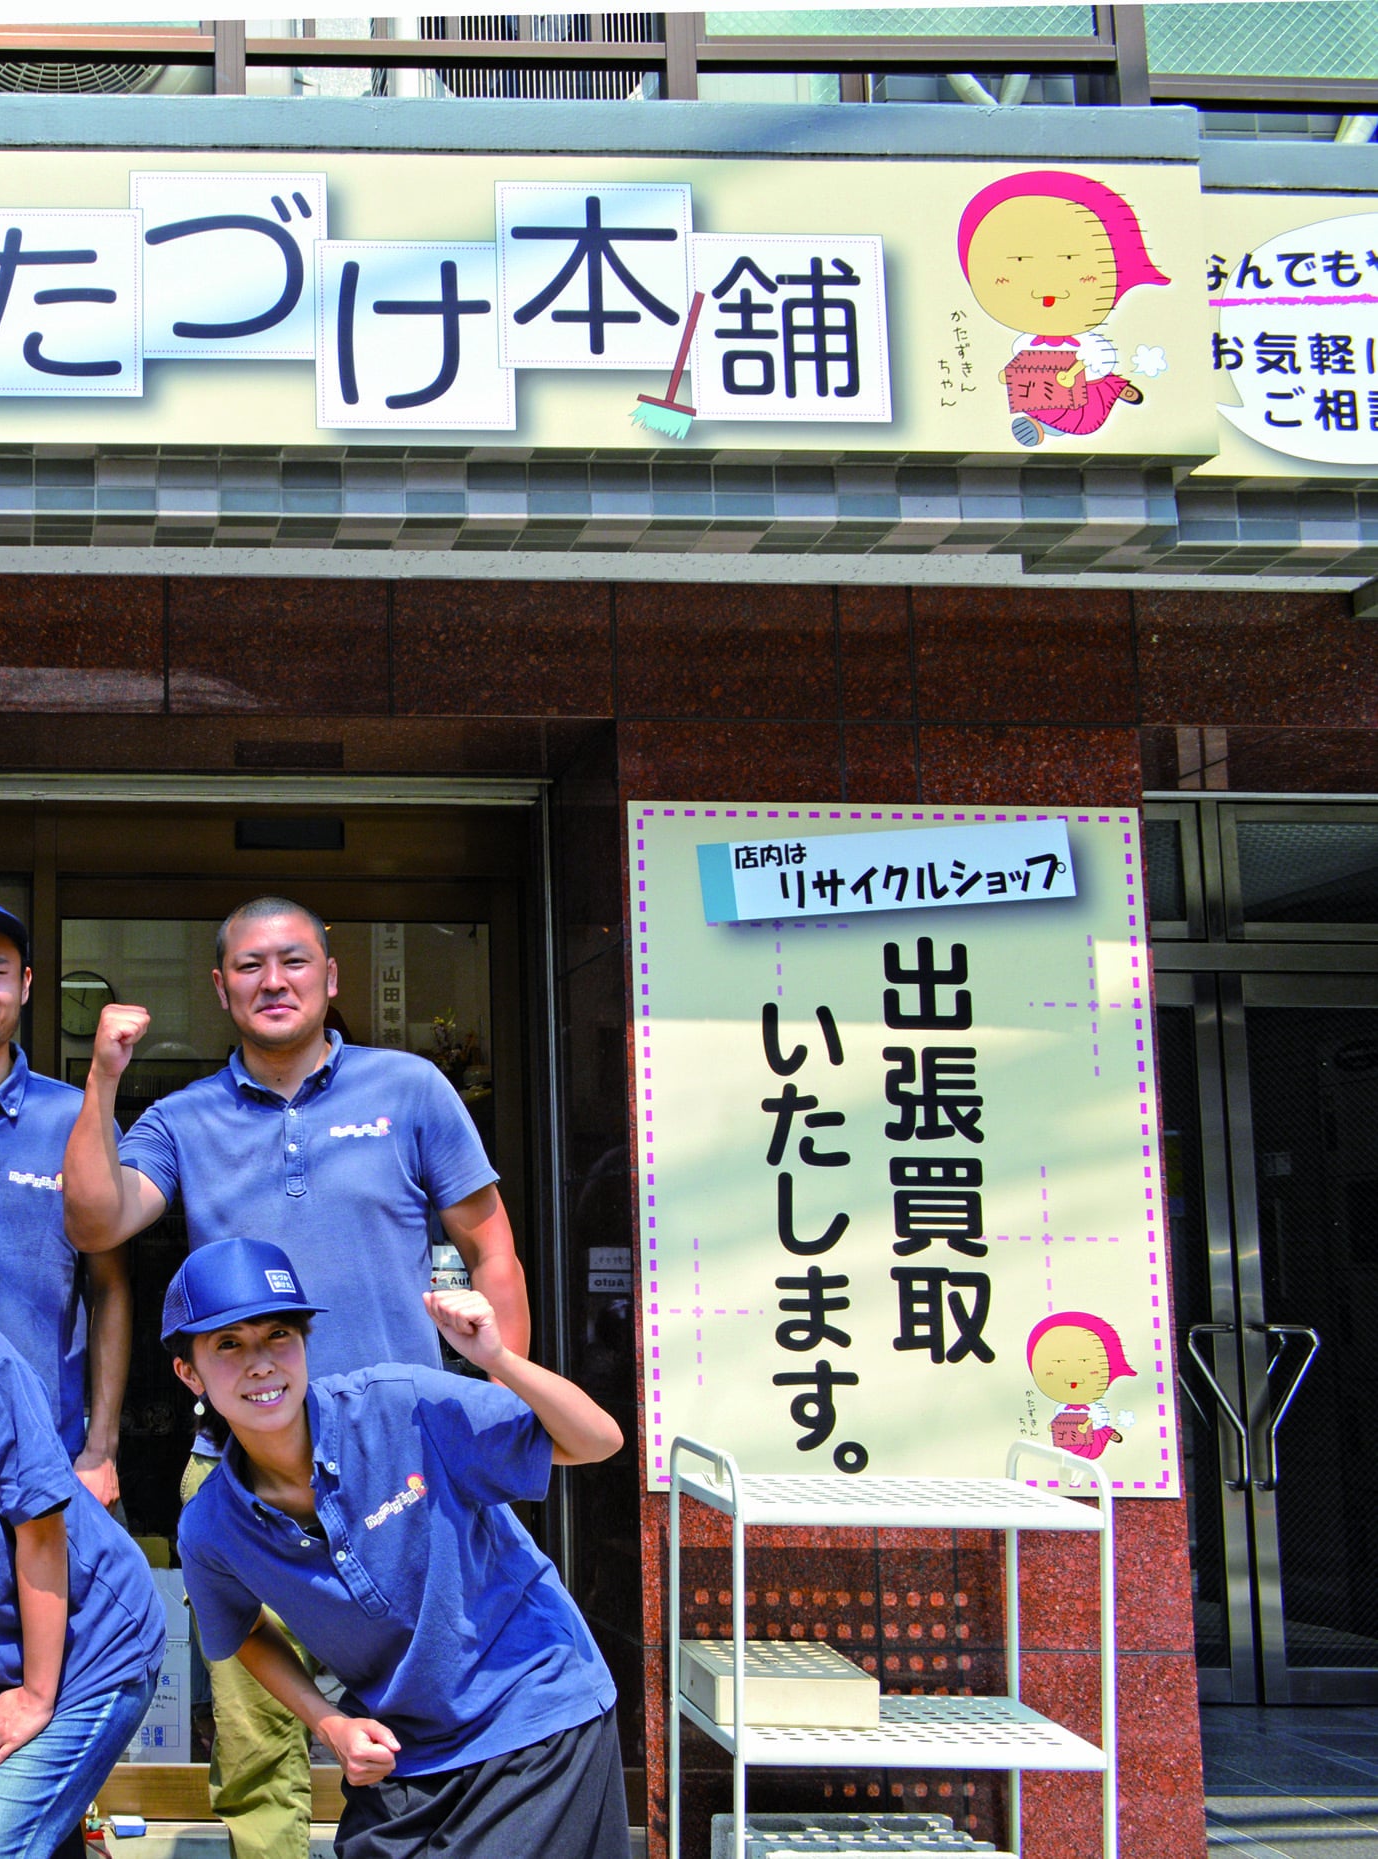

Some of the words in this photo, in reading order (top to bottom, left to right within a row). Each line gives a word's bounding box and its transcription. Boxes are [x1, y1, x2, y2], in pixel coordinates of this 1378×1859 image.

[937, 359, 957, 407] ちゃん
[1018, 380, 1054, 401] ゴミ
[734, 842, 807, 870] 店内は
[779, 852, 1067, 909] リサイクルショップ
[882, 936, 996, 1364] 出張買取
[761, 1002, 869, 1474] いたします。
